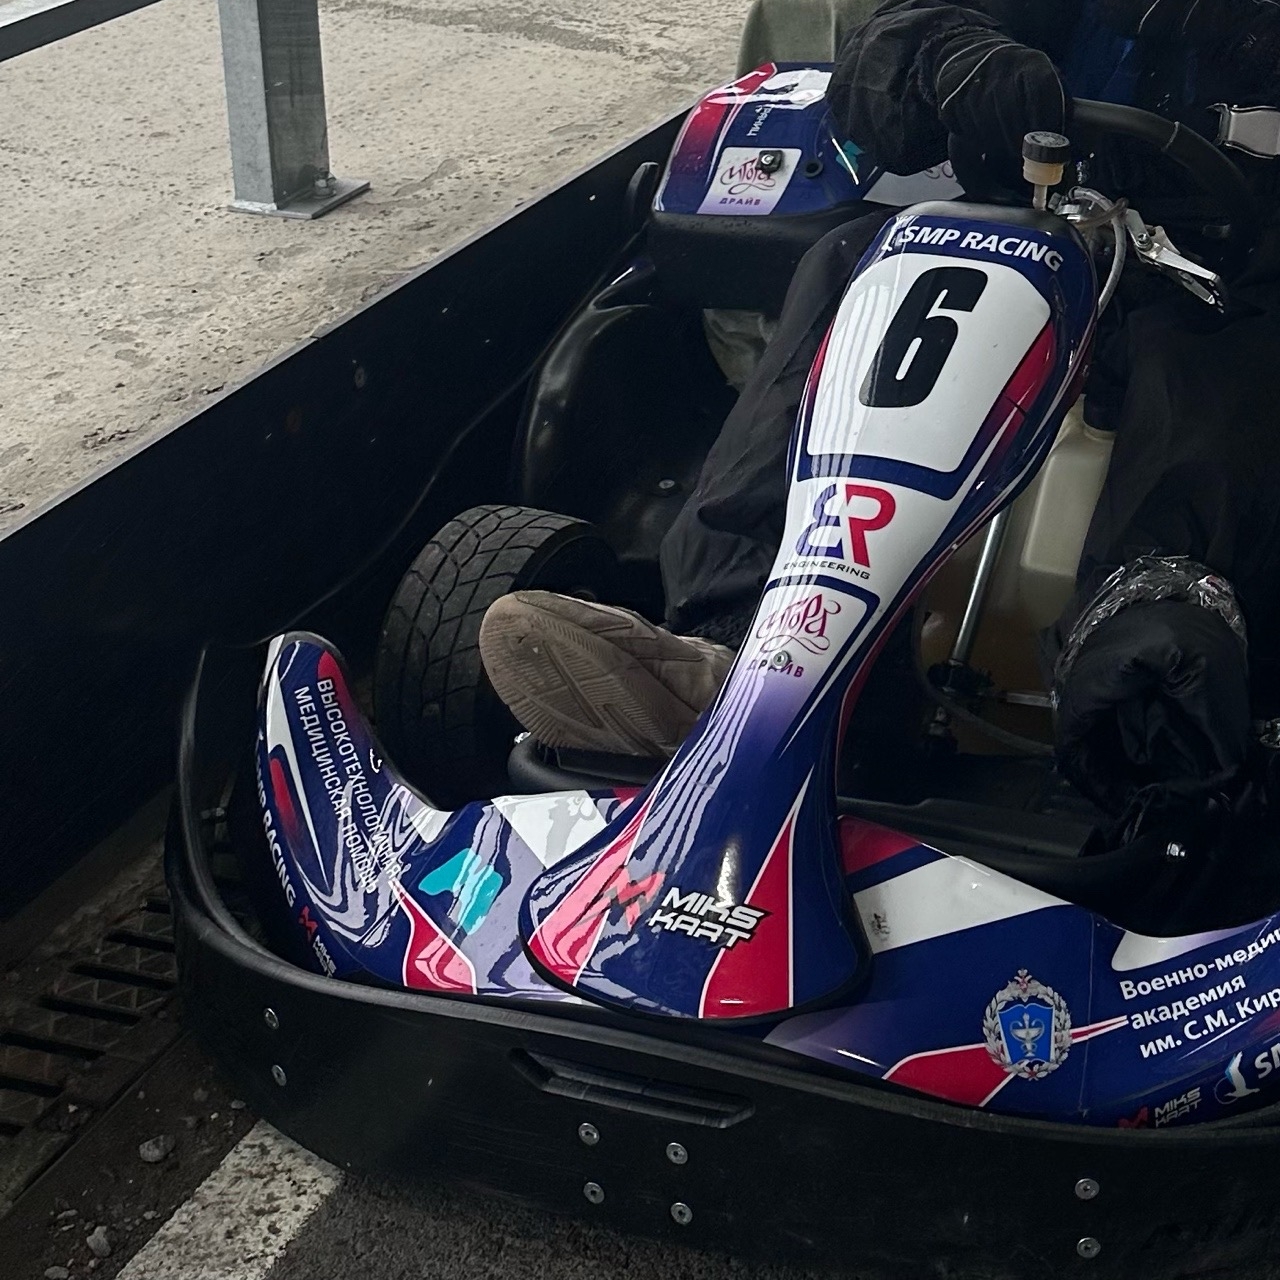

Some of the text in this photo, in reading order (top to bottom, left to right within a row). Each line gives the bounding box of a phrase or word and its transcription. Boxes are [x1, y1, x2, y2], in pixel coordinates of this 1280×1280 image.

[719, 196, 761, 206] ДРАЙВ
[900, 225, 1063, 271] SMP RACING
[859, 266, 988, 408] 6
[783, 560, 871, 580] ENGINEERING
[294, 686, 379, 894] МЕДИЦИНСКАЯ ПОМОЩЬ
[317, 678, 401, 880] ВЫСОКОТЕХНОЛОГИЧНАЯ
[262, 809, 296, 908] RACING
[648, 909, 752, 948] KART
[661, 887, 765, 930] MIKS
[1131, 975, 1246, 1030] академия
[1140, 1036, 1182, 1059] им.
[1183, 1011, 1236, 1041] С.М.
[1155, 1087, 1201, 1118] MIKS
